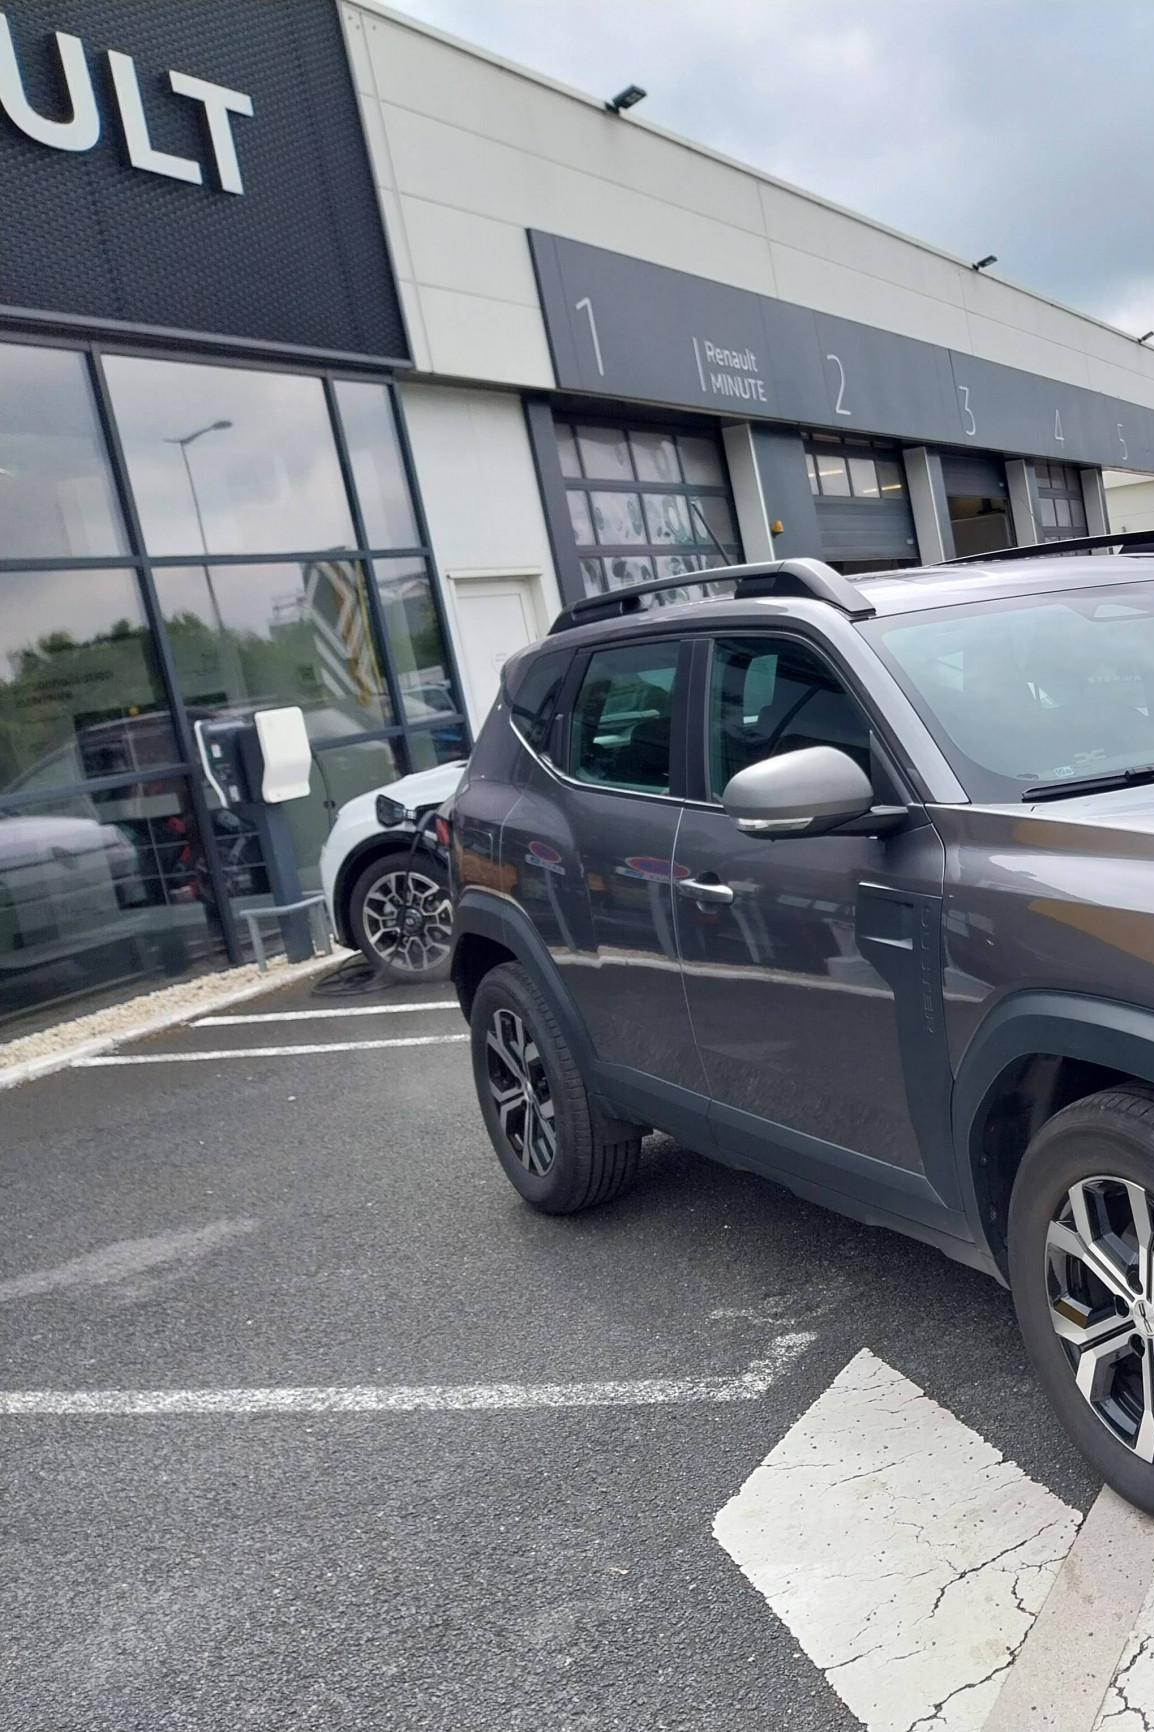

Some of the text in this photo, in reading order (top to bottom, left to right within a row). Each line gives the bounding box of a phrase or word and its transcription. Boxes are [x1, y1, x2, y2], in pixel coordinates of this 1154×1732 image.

[575, 296, 606, 377] 1
[703, 338, 758, 372] Renault
[710, 373, 767, 403] MINUTE
[826, 354, 852, 416] 2
[958, 385, 977, 437] 3
[1054, 408, 1065, 442] 4
[1118, 423, 1128, 461] 5
